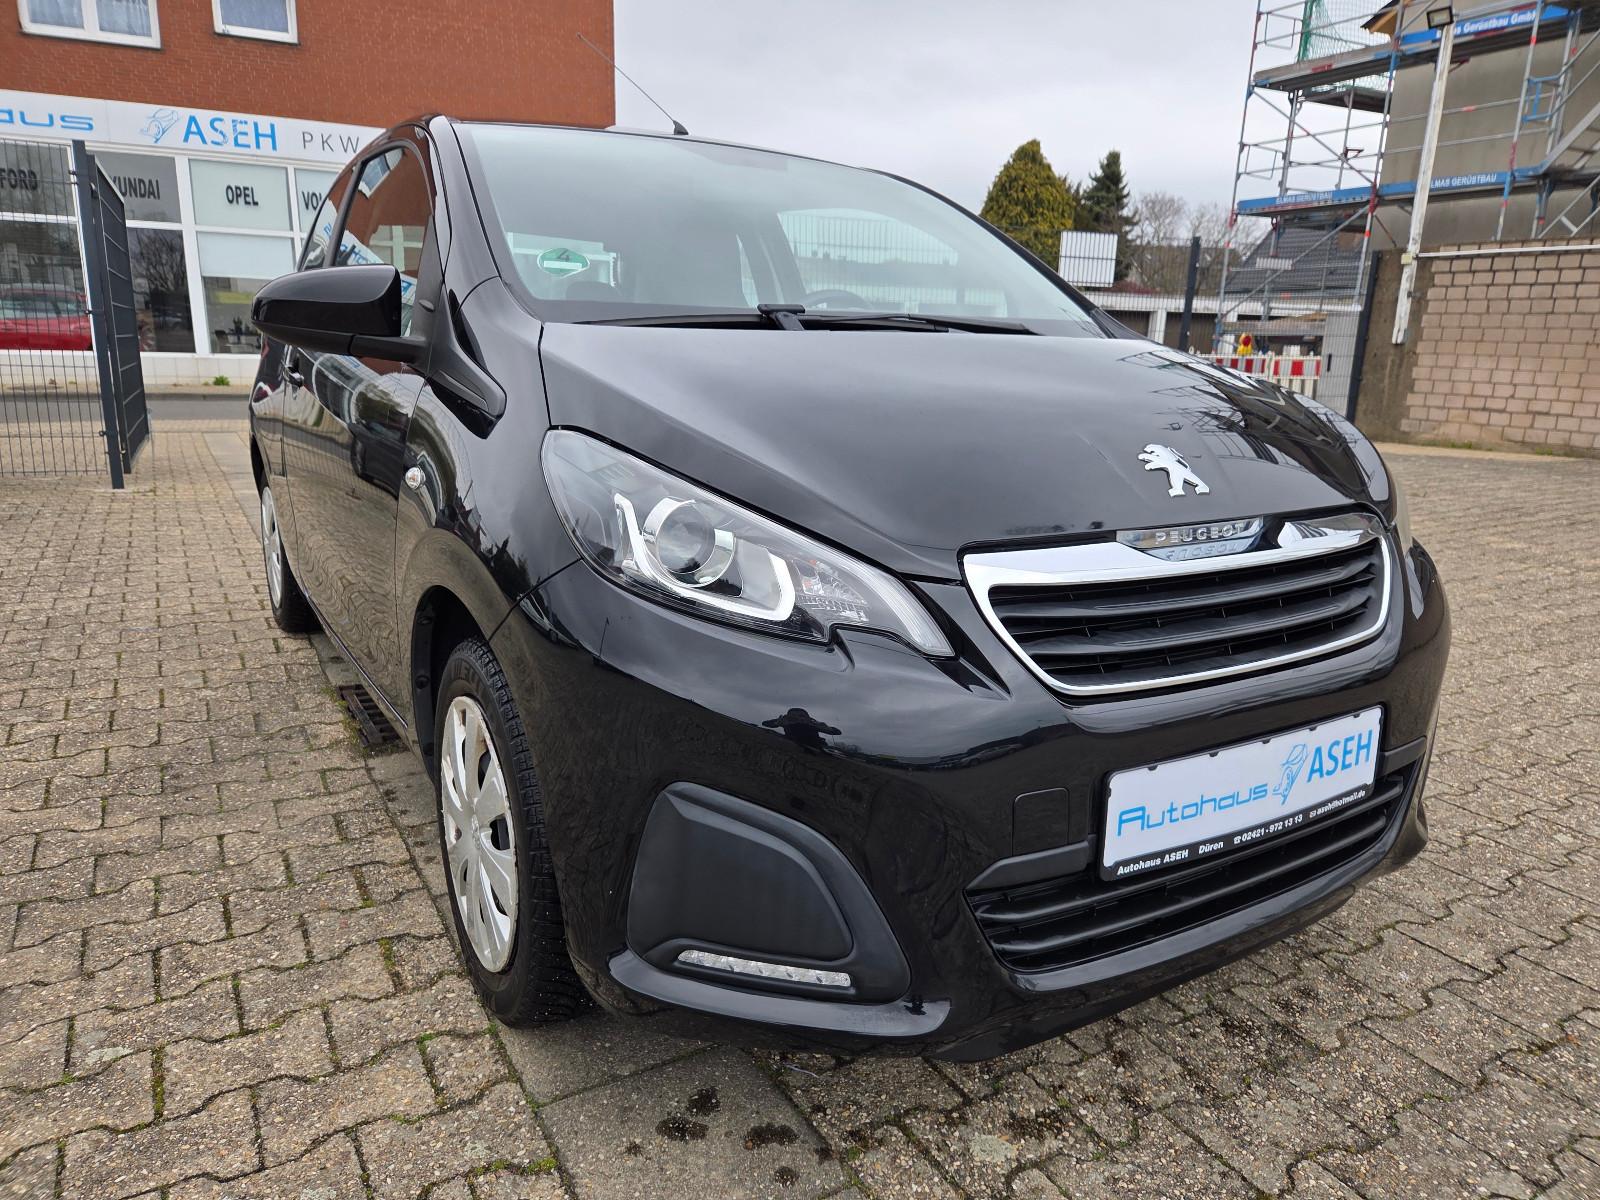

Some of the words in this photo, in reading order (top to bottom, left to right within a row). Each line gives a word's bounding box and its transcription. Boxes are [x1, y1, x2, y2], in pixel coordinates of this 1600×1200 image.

[182, 115, 278, 152] ASEH
[302, 131, 360, 154] PKW
[0, 167, 38, 191] FORD
[225, 185, 259, 206] OPEL
[1155, 522, 1245, 544] PEUGEOT
[1117, 783, 1268, 836] Autohaus
[1307, 729, 1373, 783] ASEH
[1117, 857, 1161, 875] Autohaus
[1163, 849, 1189, 864] ASEH
[1198, 841, 1224, 855] Düren
[1242, 830, 1265, 842] 02421
[1269, 822, 1283, 833] 972
[1284, 817, 1294, 827] 13
[1294, 814, 1303, 824] 13
